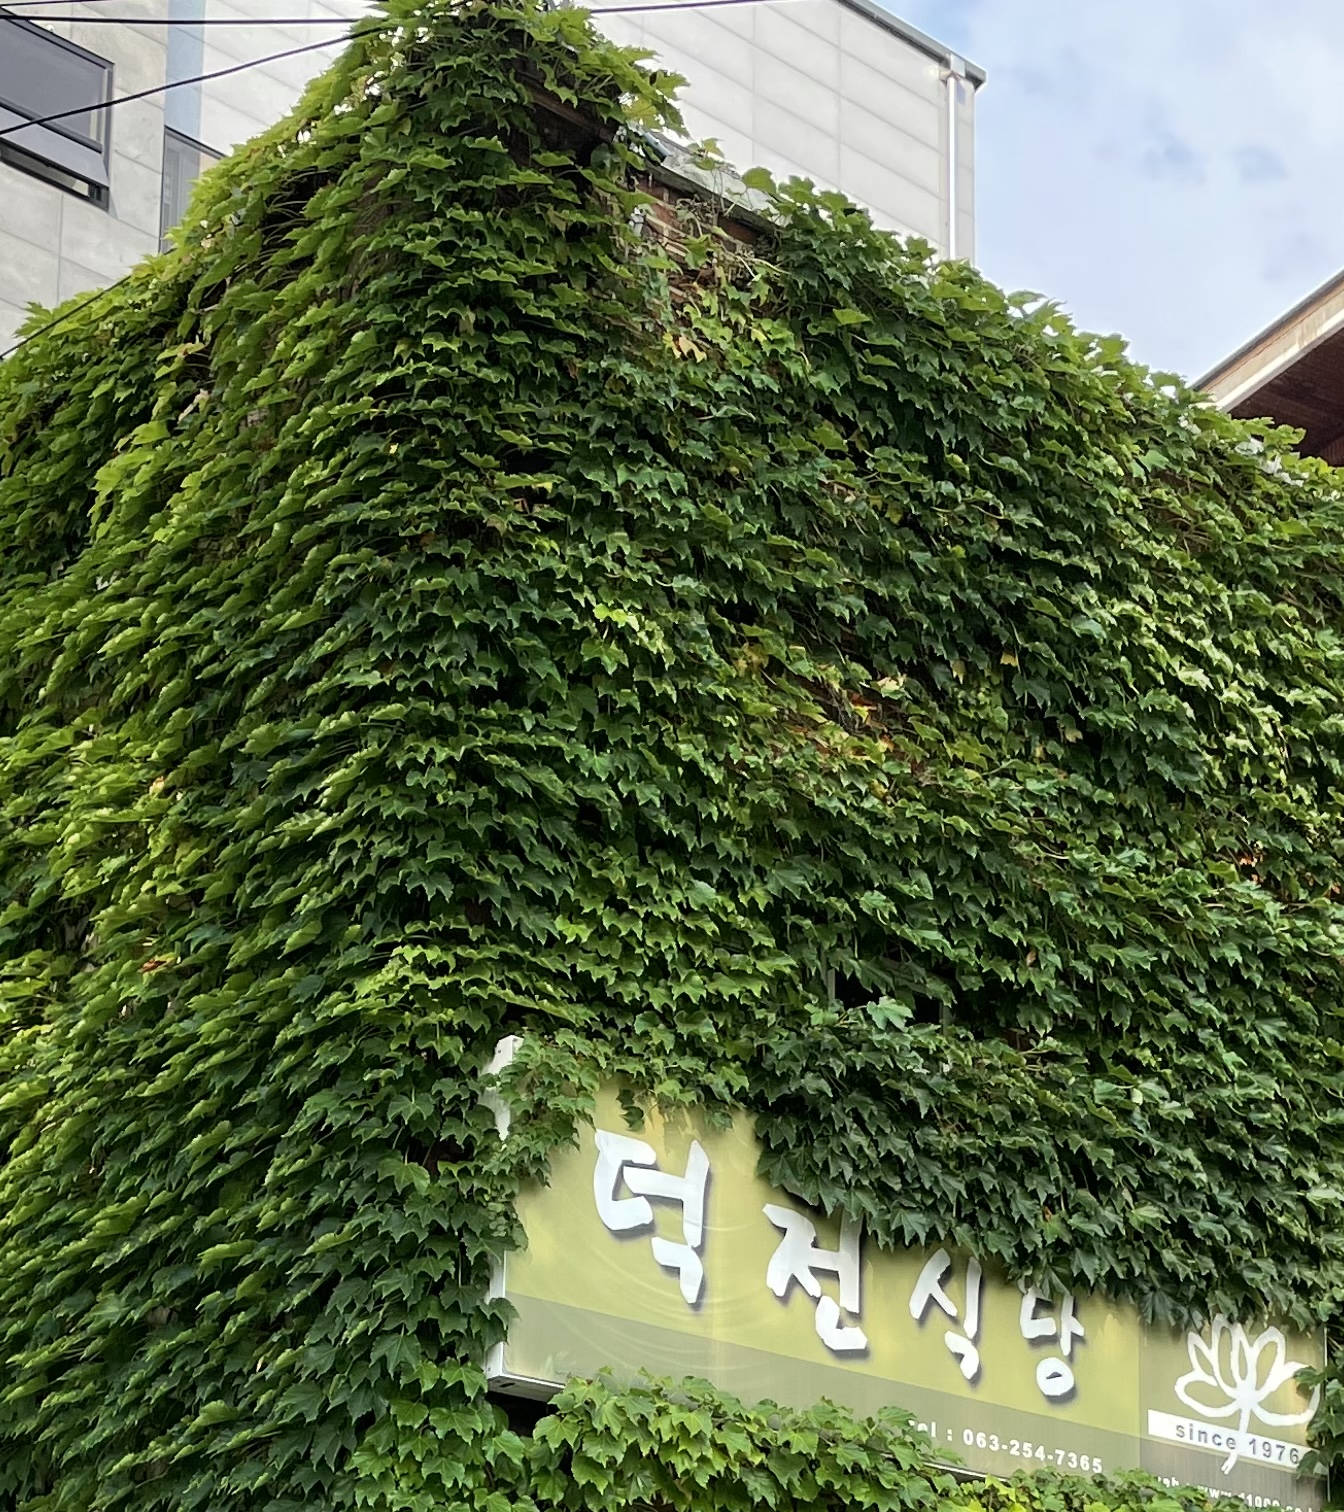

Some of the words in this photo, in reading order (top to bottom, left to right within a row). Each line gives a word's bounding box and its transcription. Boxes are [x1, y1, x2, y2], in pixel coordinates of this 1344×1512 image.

[963, 1429, 1103, 1474] 063-254-7365
[1175, 1423, 1237, 1450] since
[1249, 1438, 1300, 1465] 1976
